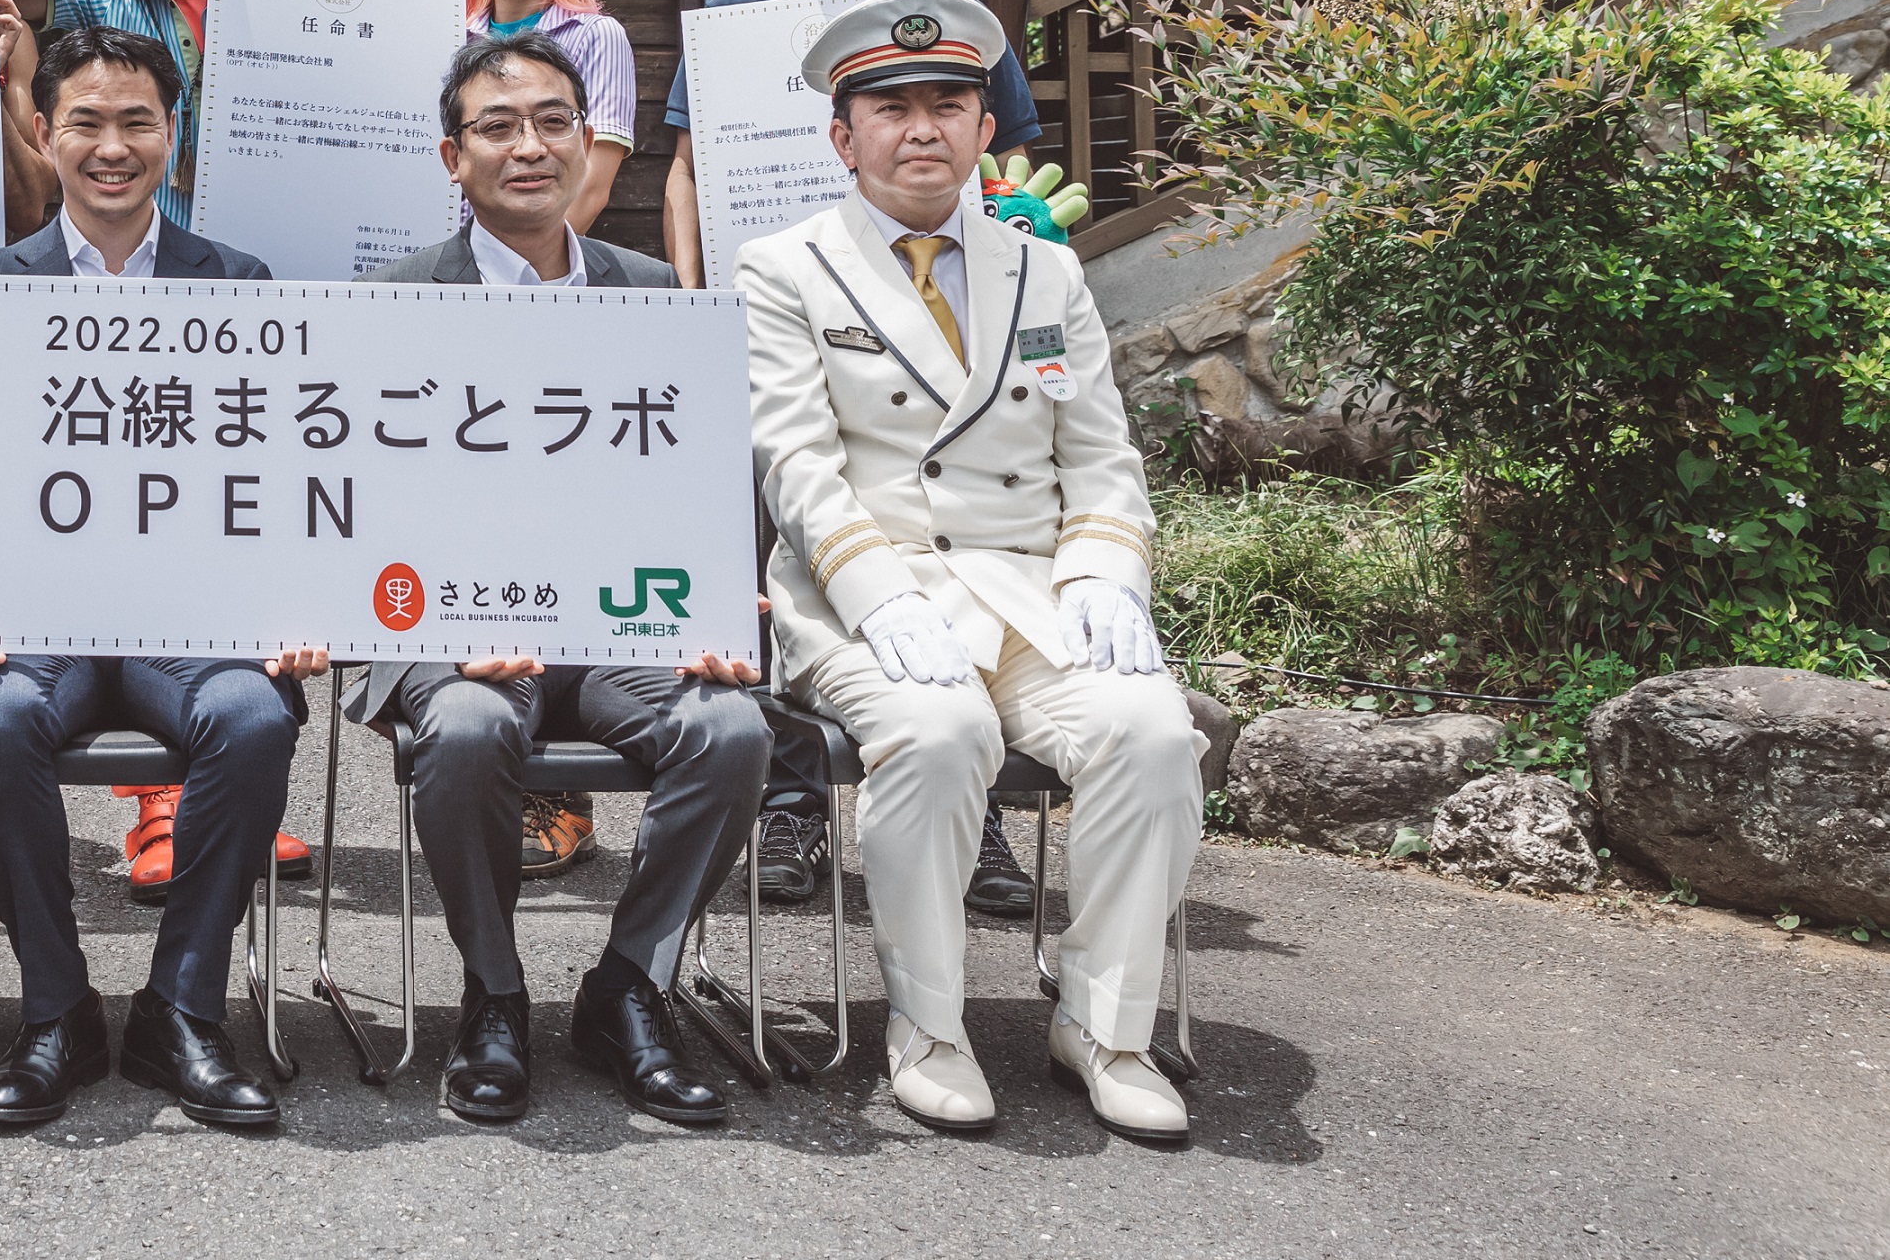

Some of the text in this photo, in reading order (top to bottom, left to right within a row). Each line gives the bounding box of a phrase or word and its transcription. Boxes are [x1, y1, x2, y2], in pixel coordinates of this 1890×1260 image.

[301, 16, 374, 38] 任命書
[905, 18, 925, 30] JR
[228, 146, 284, 159] いきましょう。
[730, 190, 851, 210] 地域の皆さまと一緒に青梅線
[732, 214, 789, 226] いきましょう。
[45, 314, 310, 356] 2022.06.01
[41, 375, 680, 456] 沿線まるごとラボ
[39, 470, 353, 538] OPEN
[440, 580, 558, 609] さとゆめ
[599, 567, 691, 618] JR
[468, 614, 509, 622] BUSINESS
[512, 615, 559, 623] INCUBATOR
[612, 622, 680, 637] JR東日本
